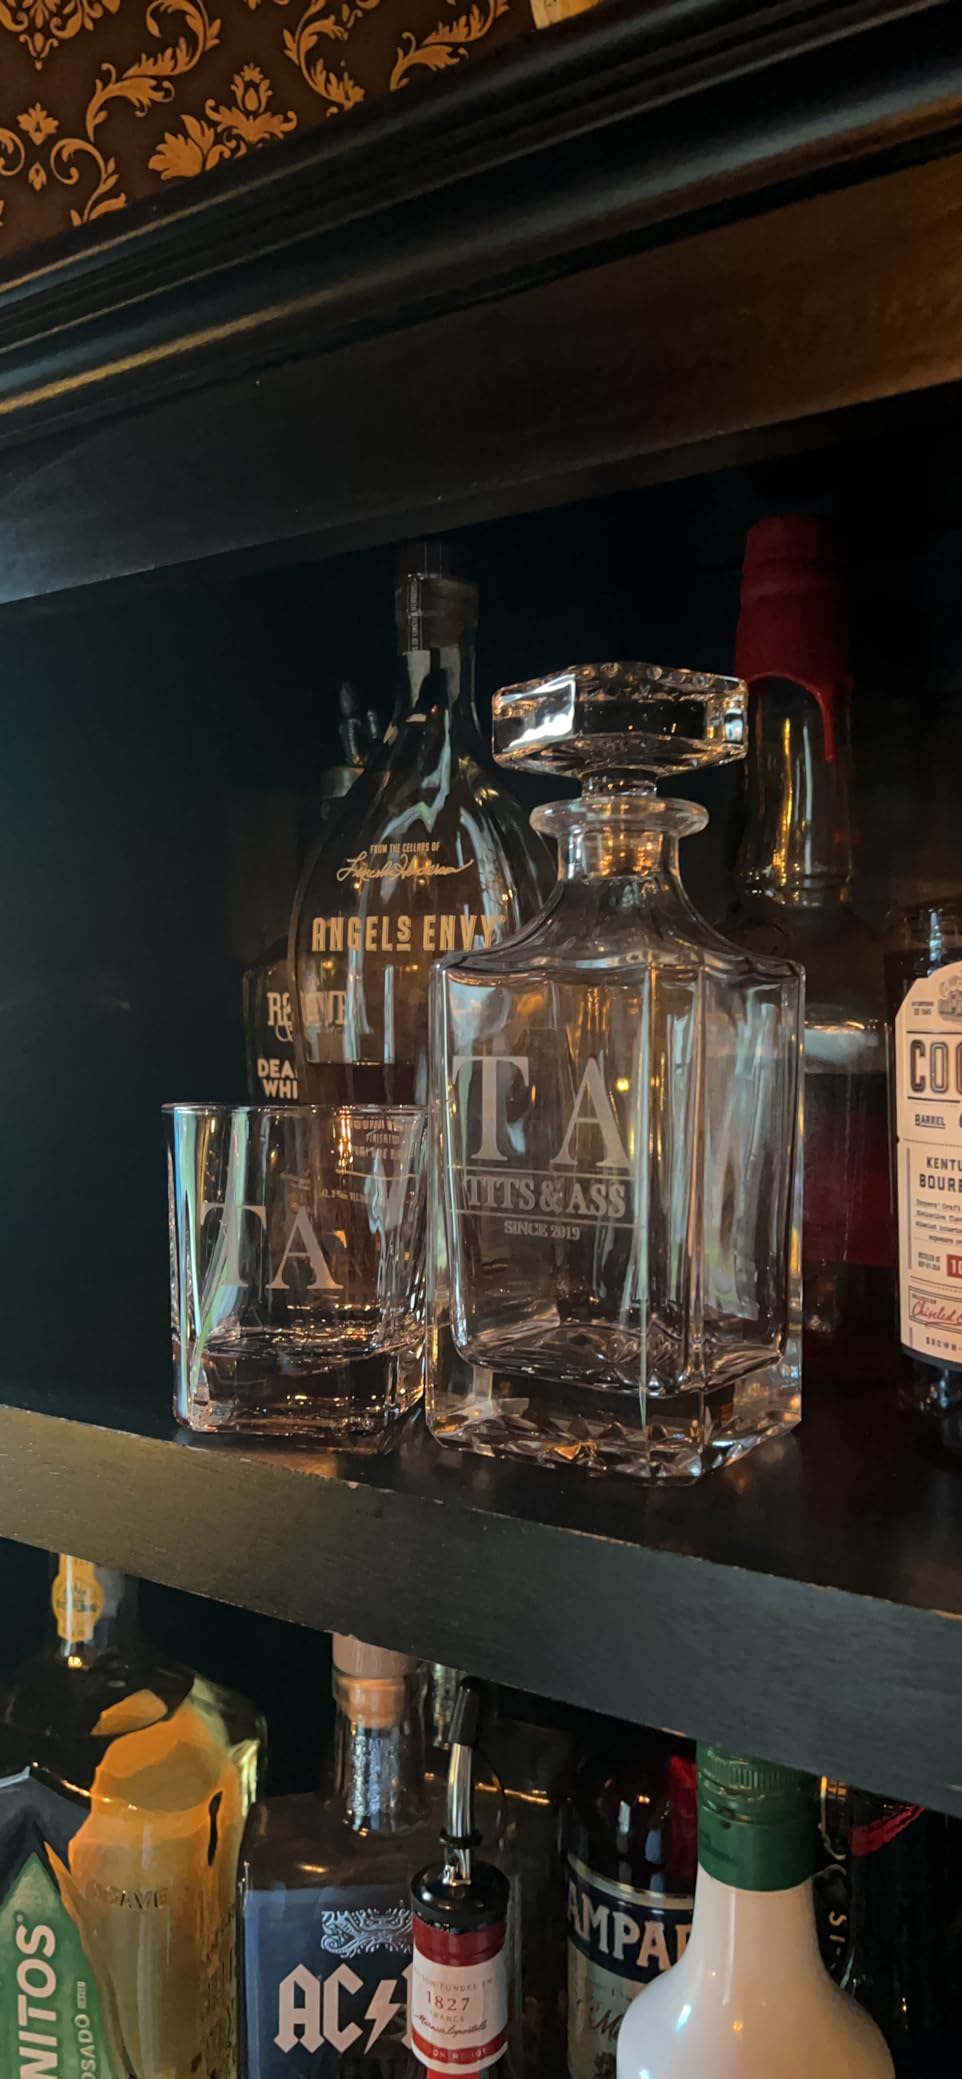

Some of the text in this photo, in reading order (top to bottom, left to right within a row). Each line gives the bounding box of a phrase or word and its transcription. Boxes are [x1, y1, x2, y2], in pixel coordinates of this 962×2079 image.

[370, 841, 440, 854] FROM THE CELLARS OF
[312, 914, 497, 951] ANGELS ENVY
[452, 1056, 632, 1169] T A
[915, 1114, 945, 1129] BARREL
[465, 1175, 626, 1218] TITS & ASS
[504, 1220, 581, 1241] SINCE 2019
[200, 1203, 344, 1290] T A
[427, 1991, 470, 2012] 1827
